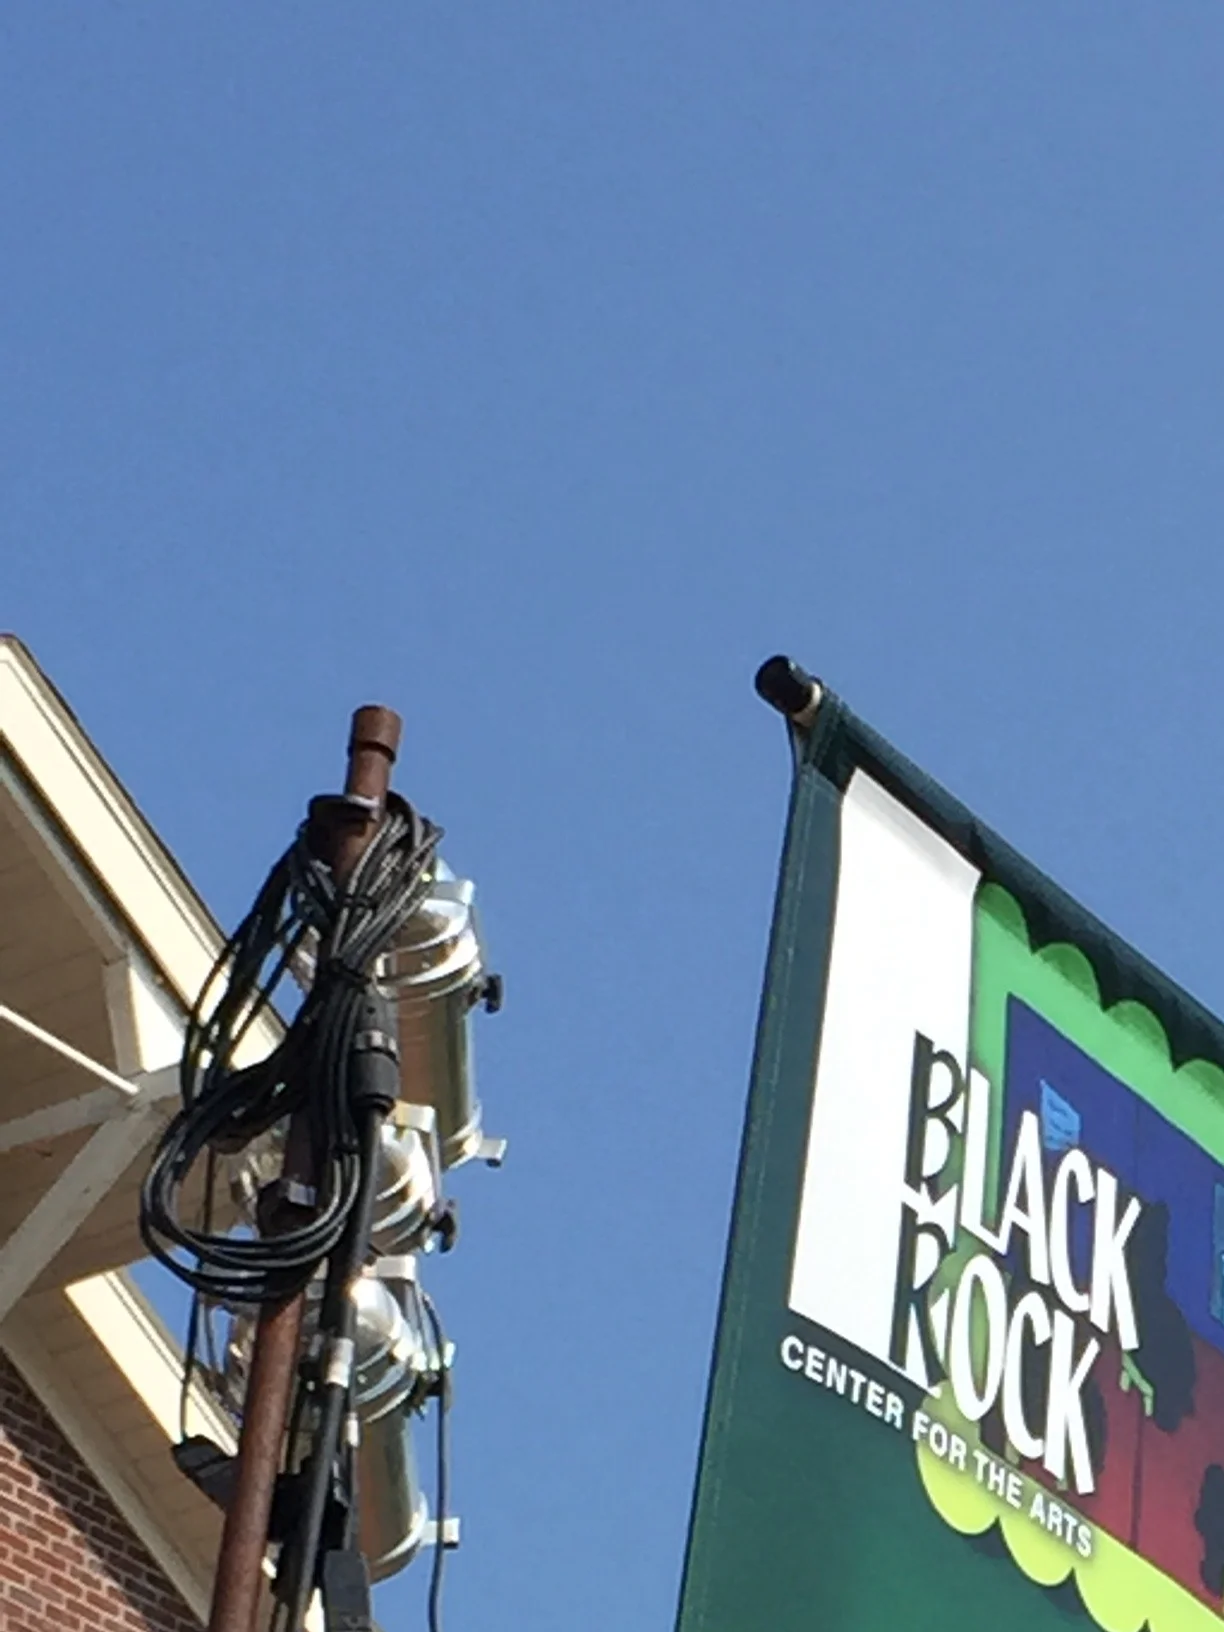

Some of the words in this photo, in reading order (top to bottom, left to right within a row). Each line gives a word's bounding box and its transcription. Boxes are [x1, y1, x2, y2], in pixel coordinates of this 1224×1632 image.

[903, 1028, 1141, 1351] BLACK
[779, 1334, 906, 1429] CENTER
[910, 1410, 968, 1472] FOR
[971, 1447, 1022, 1509] THE
[1029, 1491, 1093, 1559] ARTS
[887, 1200, 1100, 1495] ROCK
